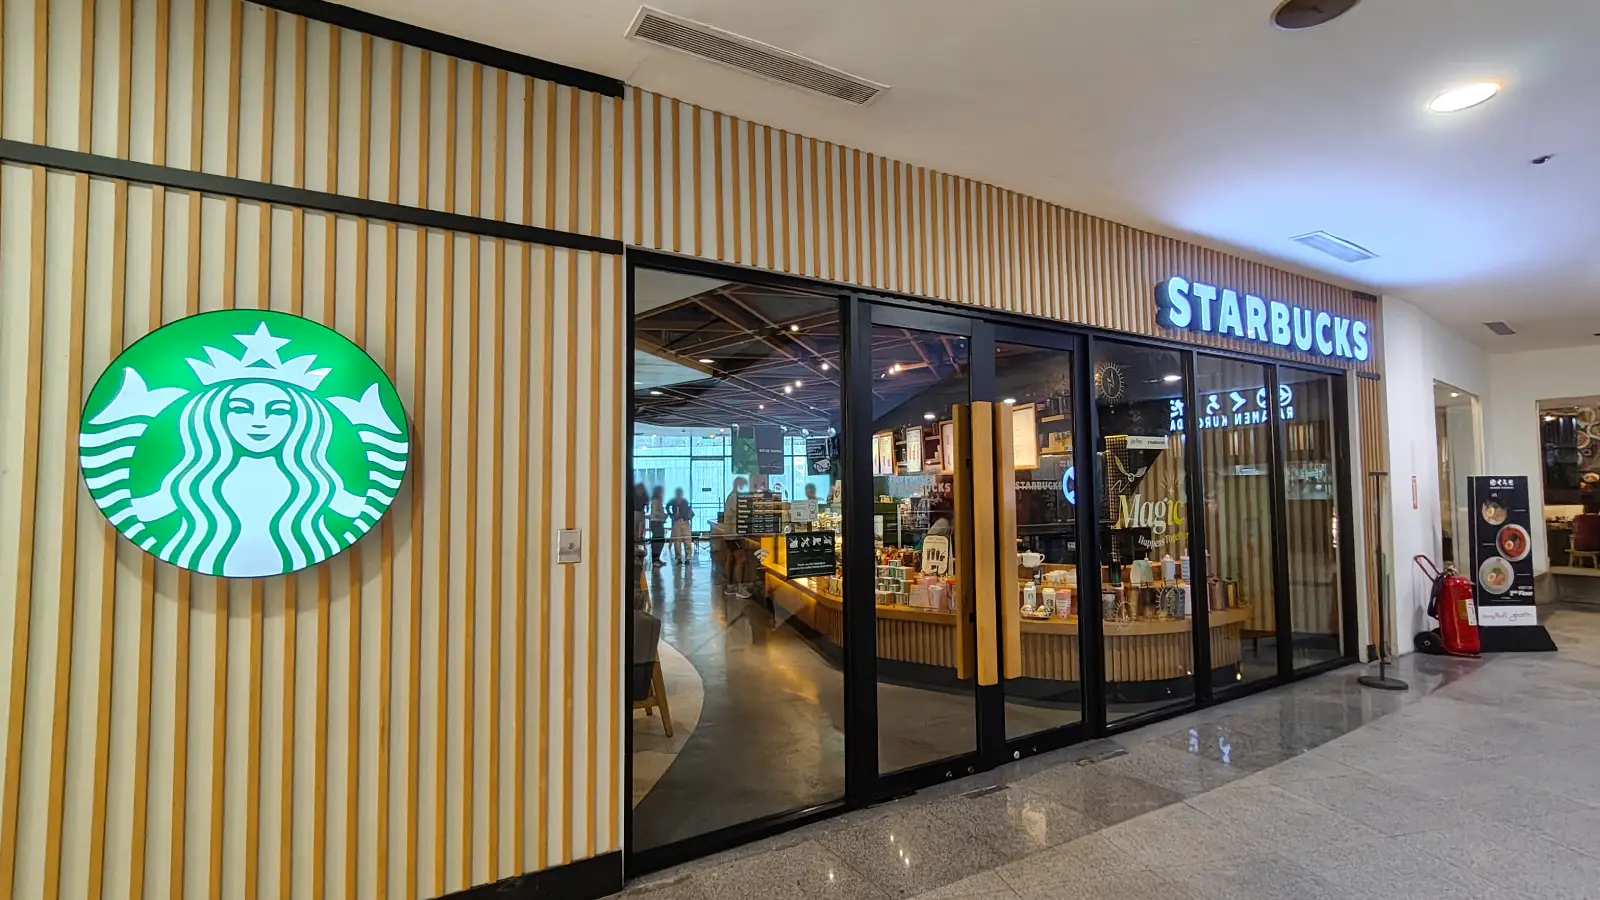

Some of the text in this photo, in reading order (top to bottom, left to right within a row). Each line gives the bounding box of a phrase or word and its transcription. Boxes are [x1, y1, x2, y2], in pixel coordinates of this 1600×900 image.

[1168, 276, 1368, 361] STARBUCKS
[1015, 480, 1063, 491] STARBUCKS
[1114, 493, 1185, 535] Magic
[1137, 534, 1165, 550] Happens
